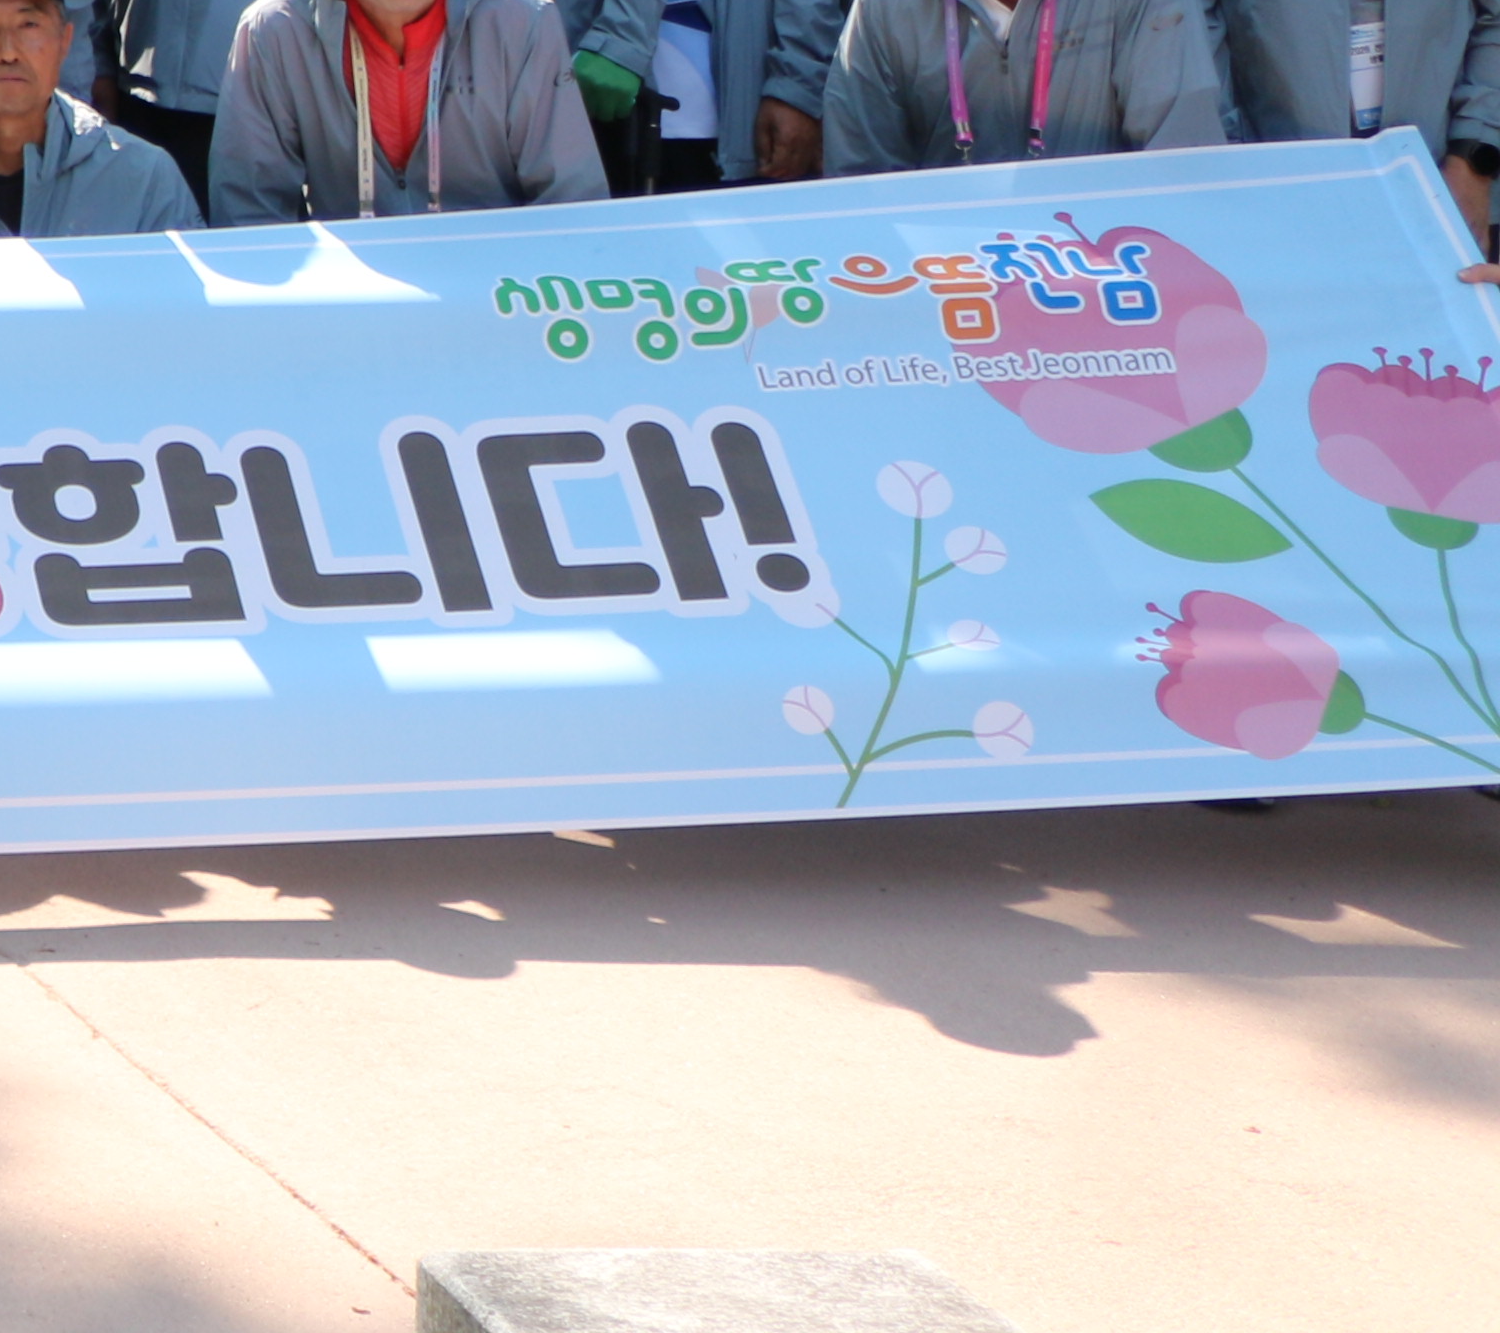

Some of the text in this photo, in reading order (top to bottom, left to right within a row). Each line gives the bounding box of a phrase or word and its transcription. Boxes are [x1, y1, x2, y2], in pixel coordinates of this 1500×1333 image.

[757, 349, 1173, 391] Land of Life, Best Jeonnam
